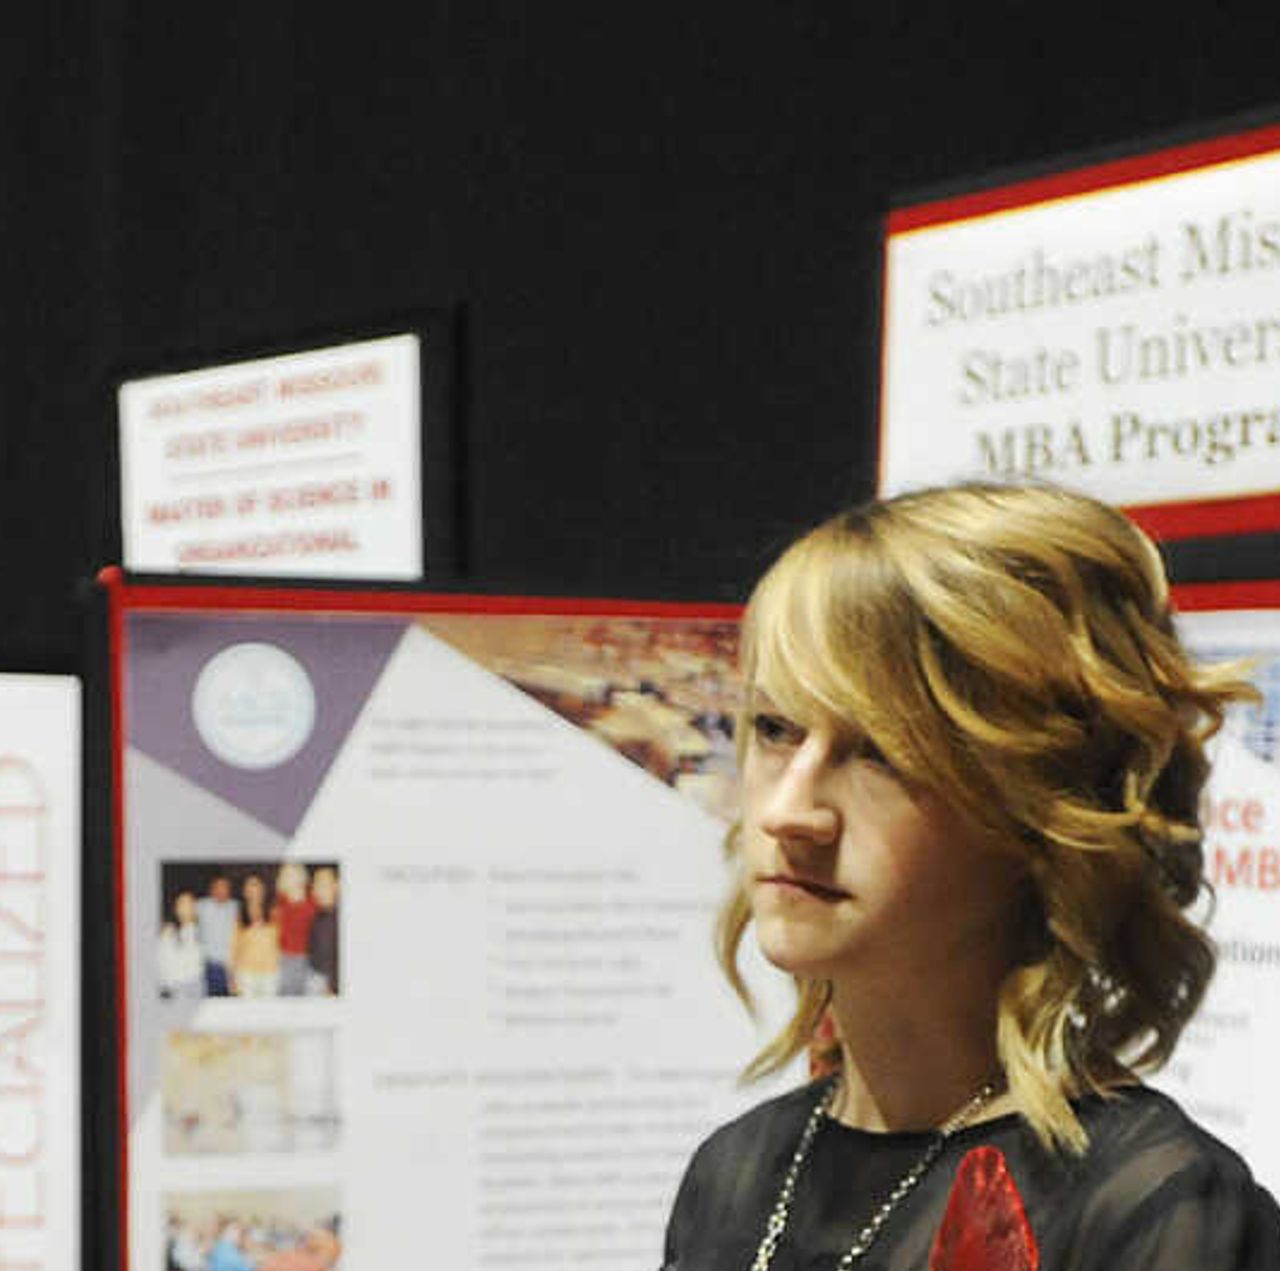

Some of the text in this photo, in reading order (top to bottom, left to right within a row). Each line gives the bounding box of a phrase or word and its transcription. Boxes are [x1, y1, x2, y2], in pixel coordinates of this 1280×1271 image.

[926, 237, 1162, 325] Southeast
[960, 347, 1080, 407] State
[974, 424, 1094, 475] MBA
